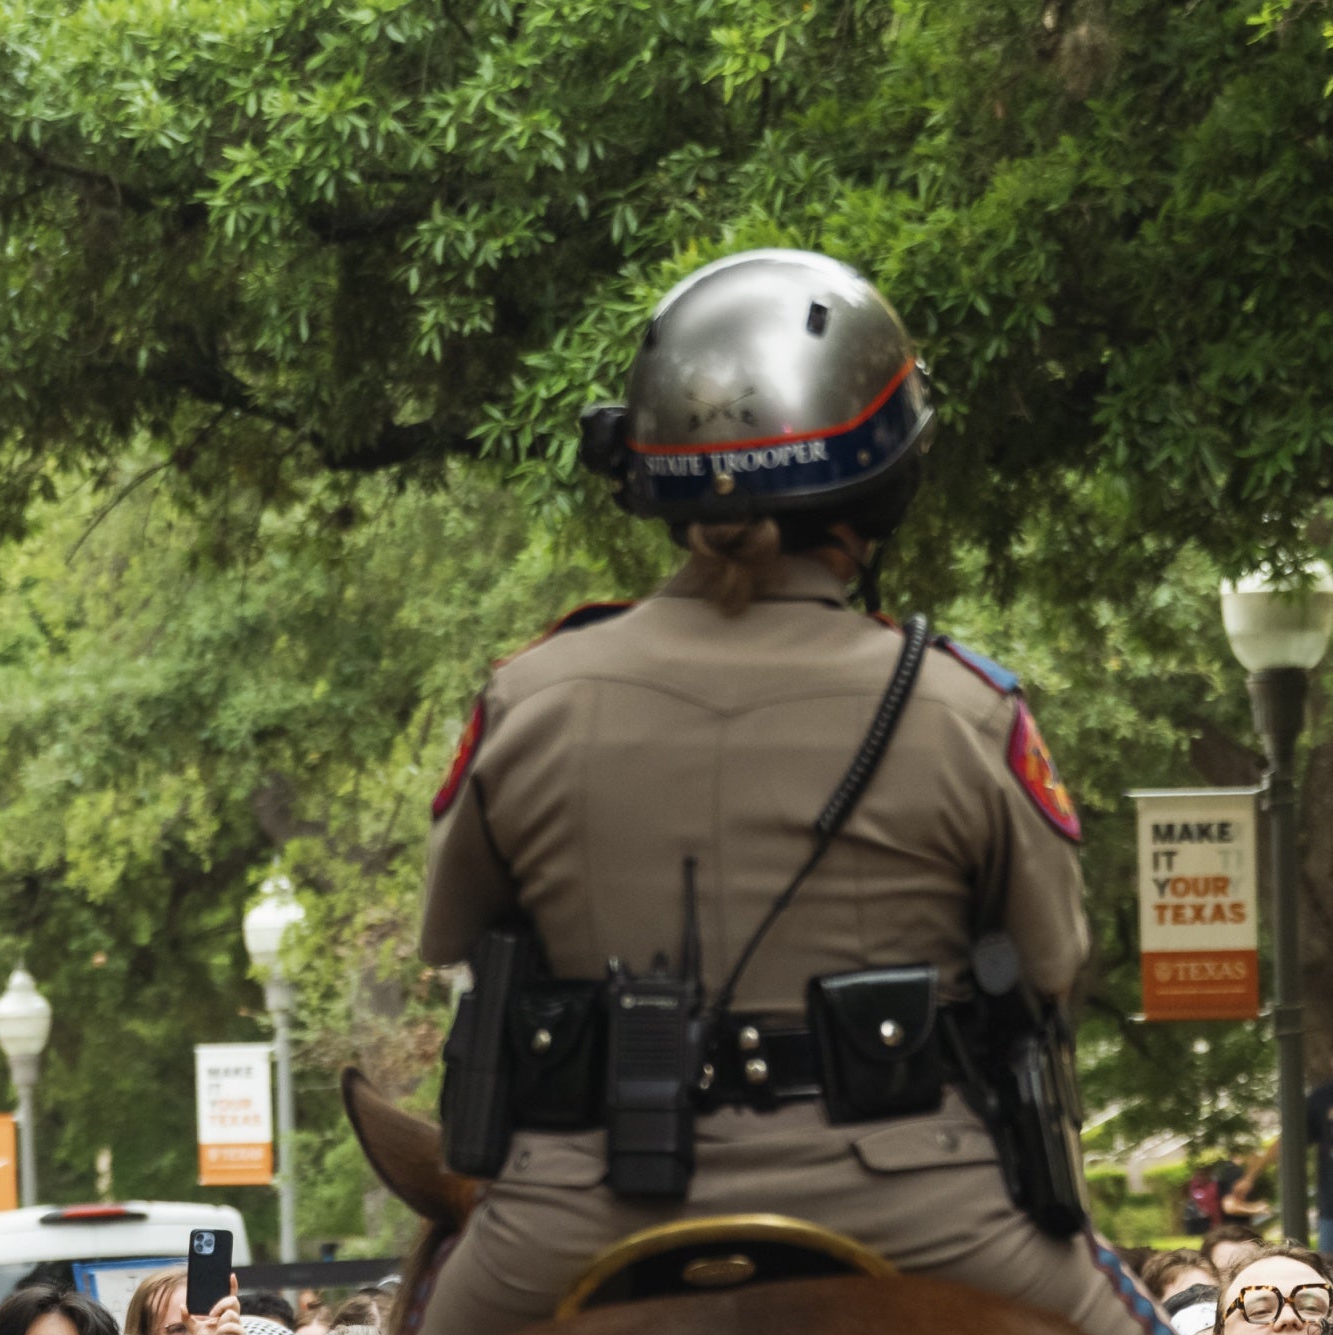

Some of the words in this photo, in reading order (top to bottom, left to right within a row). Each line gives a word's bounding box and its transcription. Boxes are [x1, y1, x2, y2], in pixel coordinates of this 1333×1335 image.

[709, 438, 829, 475] TROOPER
[1151, 822, 1233, 844] MAKE
[1152, 850, 1177, 873] IT
[1152, 875, 1231, 900] YOUR
[1153, 903, 1247, 926] TEXAS
[1175, 961, 1247, 982] TEXAS
